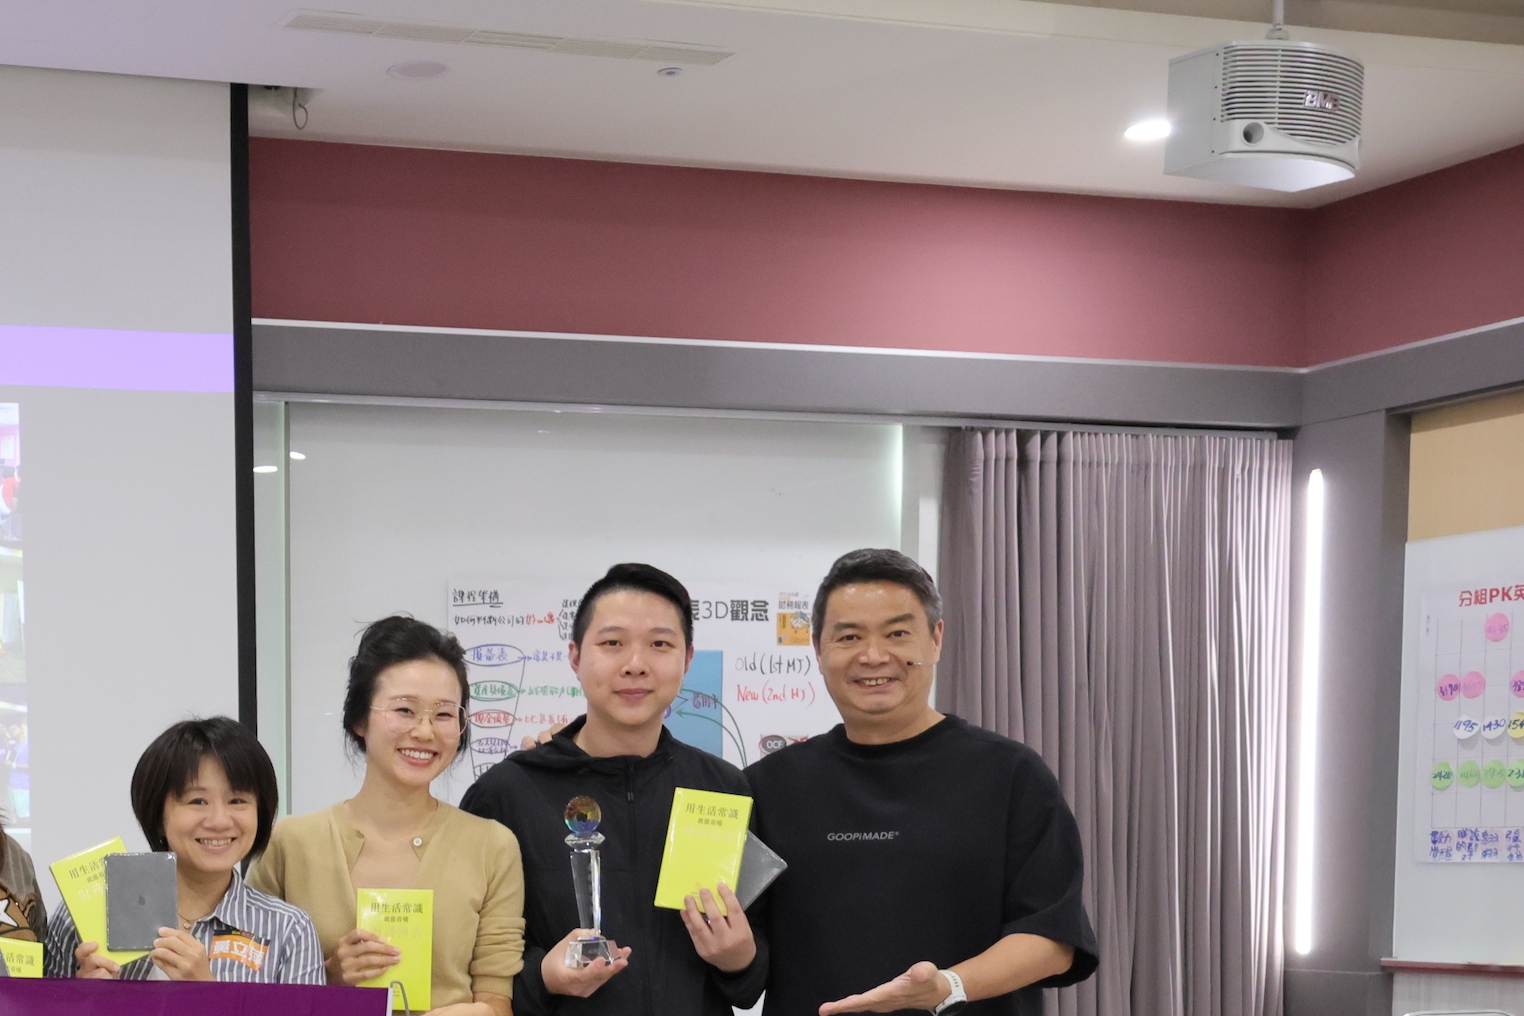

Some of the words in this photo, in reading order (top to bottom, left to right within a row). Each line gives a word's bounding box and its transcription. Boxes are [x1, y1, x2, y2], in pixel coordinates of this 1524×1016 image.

[766, 741, 783, 749] OCF
[685, 803, 739, 819] 用生活常識
[370, 902, 423, 914] 用生活常識
